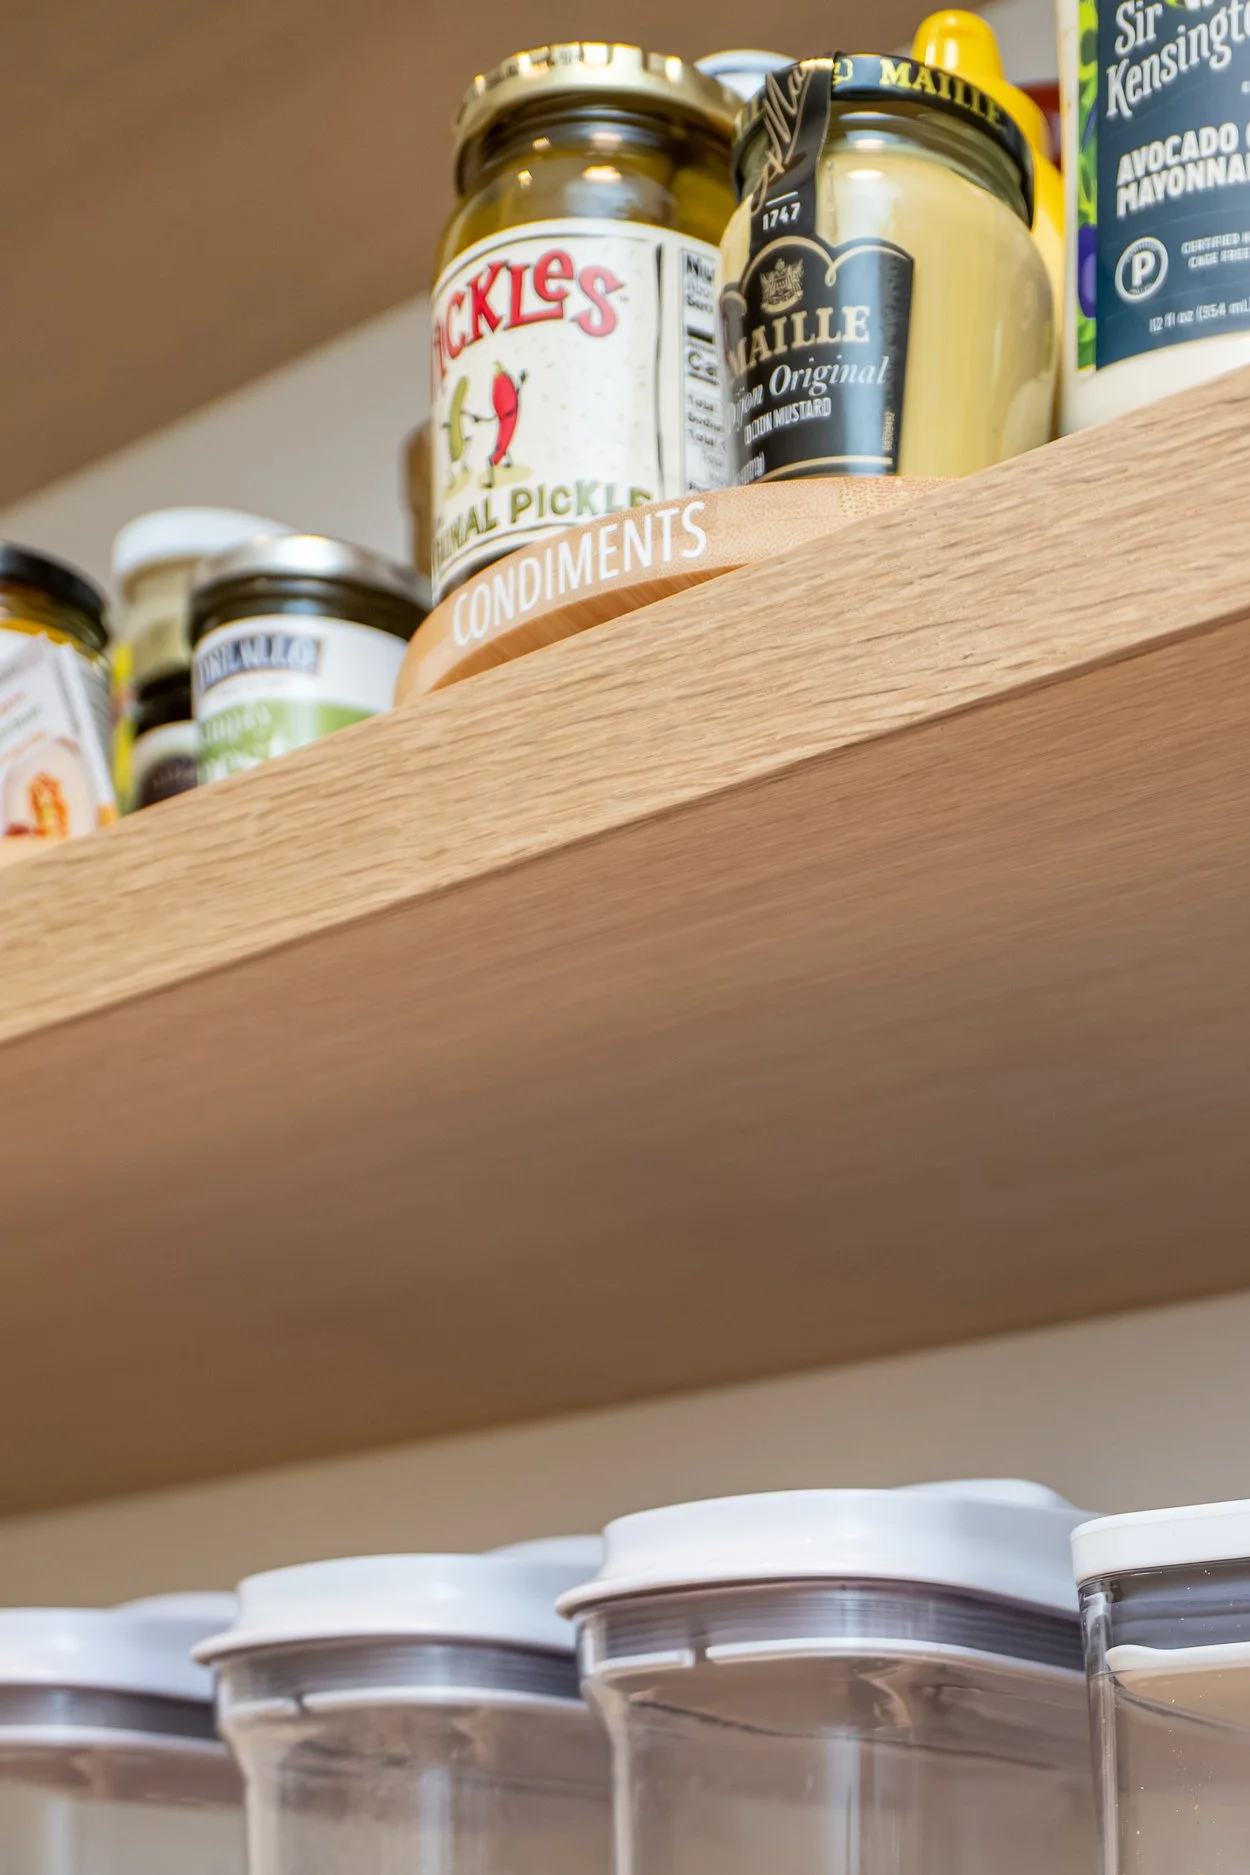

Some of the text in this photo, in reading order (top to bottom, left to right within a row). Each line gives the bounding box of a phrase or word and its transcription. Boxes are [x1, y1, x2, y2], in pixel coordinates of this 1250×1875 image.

[1113, 0, 1164, 56] Sir
[879, 57, 1006, 127] MAILLE
[1116, 121, 1240, 187] AVOCADO
[761, 201, 801, 232] 1747
[769, 354, 890, 397] Original
[773, 396, 833, 430] MUSTARD
[452, 501, 708, 647] CONDIMENTS
